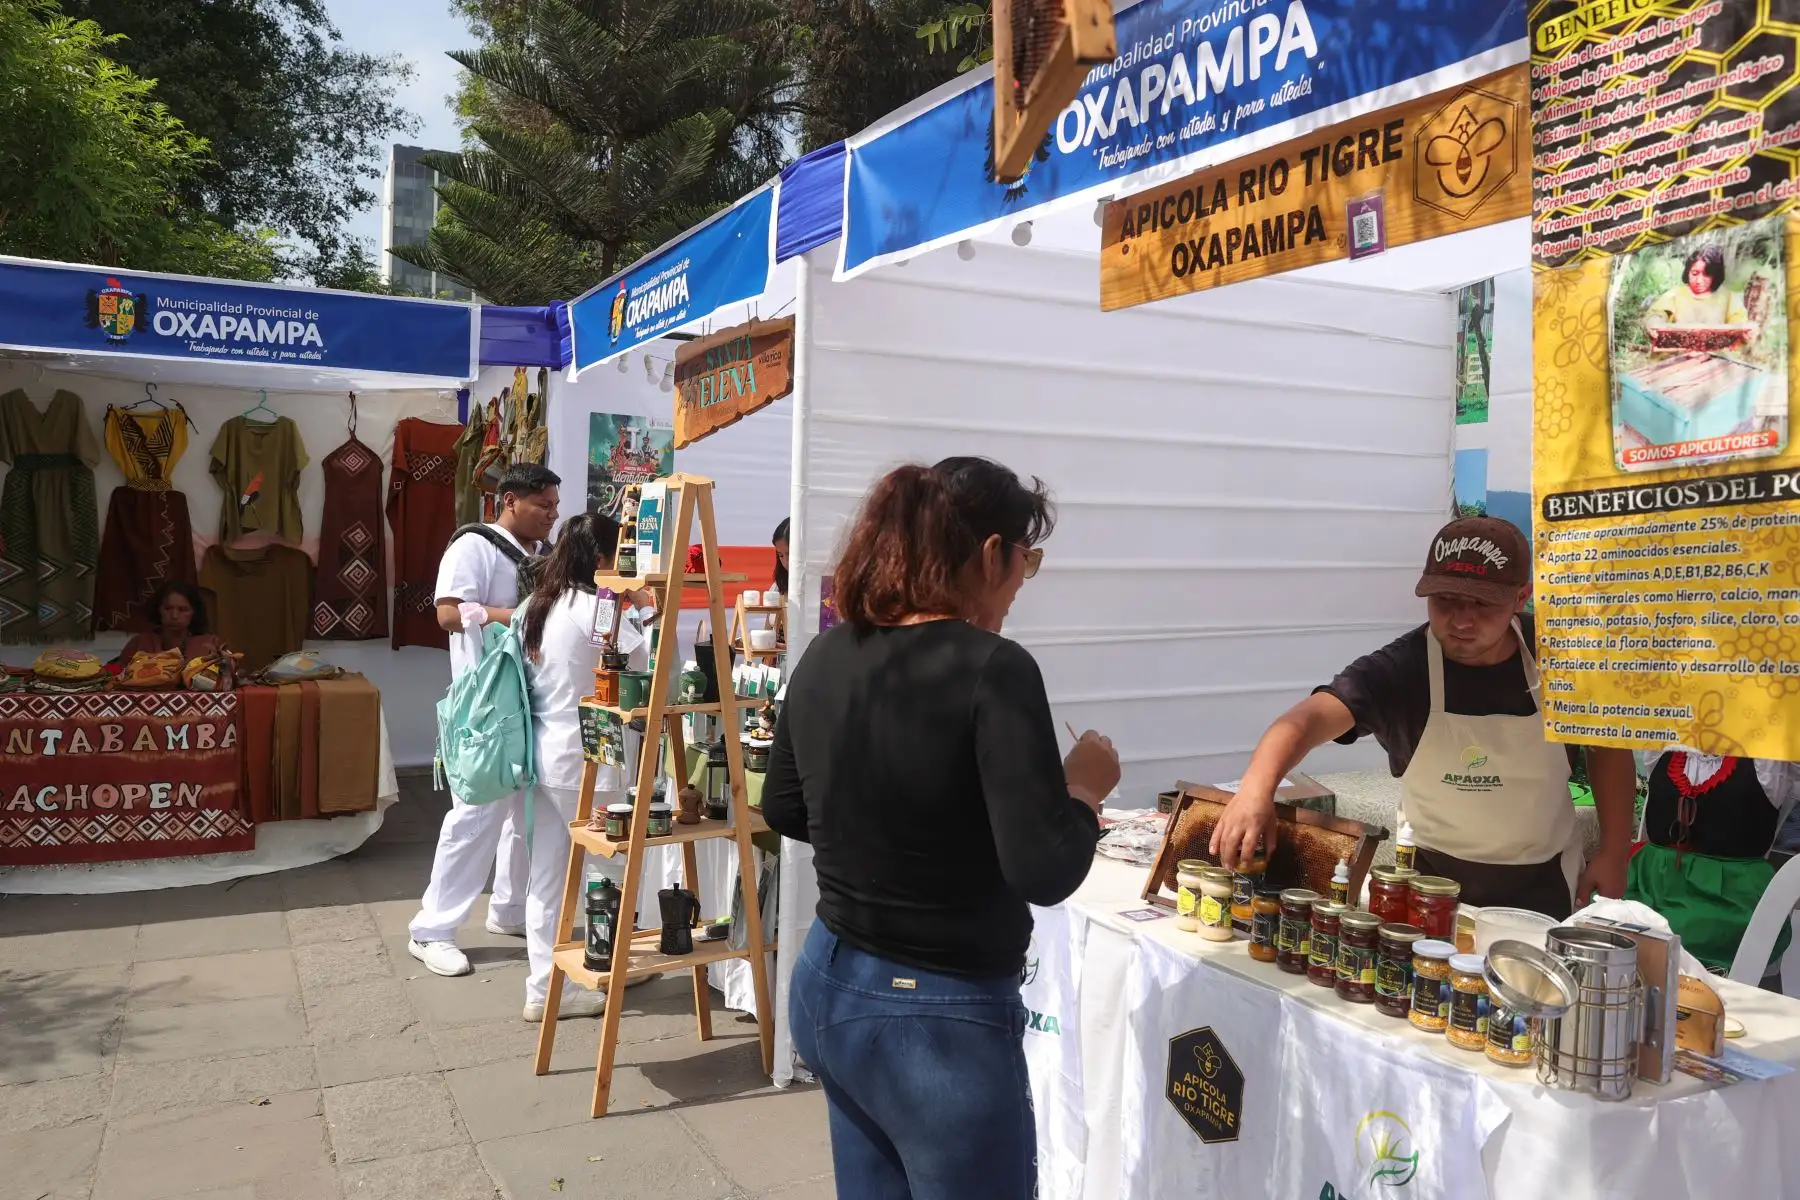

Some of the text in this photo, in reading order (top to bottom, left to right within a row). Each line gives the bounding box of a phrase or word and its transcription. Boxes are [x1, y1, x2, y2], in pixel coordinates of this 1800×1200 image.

[1541, 3, 1722, 77] Regula el azúcar en la sangre
[1544, 0, 1657, 46] BENEFIC
[1081, 25, 1176, 88] nicipalidad
[1542, 28, 1701, 99] Mejora la función cerebral
[1056, 0, 1318, 154] OXAPAMPA
[1542, 72, 1668, 121] Minimiza las alergias
[1542, 57, 1783, 145] Estimulante del sistema inmunológico
[1156, 132, 1176, 150] con
[1180, 112, 1216, 140] ustedes
[1220, 112, 1229, 132] y
[1234, 97, 1265, 126] para
[1543, 148, 1580, 166] Reduce
[1582, 139, 1594, 154] el
[1596, 128, 1632, 149] estrés
[1543, 165, 1596, 188] Promueve
[1599, 157, 1611, 171] la
[1694, 122, 1716, 141] del
[1720, 113, 1761, 134] sueño
[1120, 119, 1405, 242] APICOLA RIO TIGRE
[1542, 192, 1588, 211] Previene
[1591, 172, 1643, 198] infección
[1647, 166, 1661, 180] de
[1664, 145, 1745, 178] quemaduras
[1748, 141, 1757, 155] y
[1542, 167, 1749, 233] Tratamiento para el estreñimiento
[1542, 236, 1580, 256] Regula
[1583, 233, 1599, 245] los
[1602, 222, 1649, 245] procesos
[1652, 197, 1733, 226] hormonales
[1736, 194, 1754, 208] en
[1757, 184, 1771, 201] el
[1171, 205, 1327, 278] OXAPAMPA
[157, 296, 319, 320] Municipalidad Provincial de
[626, 273, 690, 329] OXAPAMPA
[153, 310, 324, 348] OXAPAMPA
[246, 347, 269, 357] ustedes
[271, 351, 278, 360] y
[280, 351, 297, 360] para
[700, 360, 757, 409] ELENA
[1629, 432, 1769, 462] SOMOS APICULTORES
[1548, 485, 1700, 517] BENEFICIOS
[1701, 476, 1766, 502] DEL
[1548, 513, 1800, 542] Contiene aproximadamente 25% de protein
[1435, 536, 1509, 570] Oxapampa
[1548, 540, 1741, 565] Aporta 22 aminoacidos esenciales.
[1548, 573, 1591, 584] Contiene
[1595, 569, 1649, 582] vitaminas
[1549, 587, 1800, 607] Aporta minerales como Hierro, calcio, man
[1546, 610, 1800, 629] mangnesio, potasio, fosforo, silice, cloro, co
[1549, 636, 1715, 651] Restablece la flora bacteriana.
[1549, 658, 1800, 674] Fortalece el crecimiento y desarrollo de los
[1549, 680, 1576, 691] niños.
[1553, 701, 1693, 718] Mejora la potencia sexual.
[1554, 721, 1679, 740] Contrarresta la anemia.
[1444, 773, 1500, 783] APAOXA
[1173, 1081, 1235, 1128] RIO TIGRE
[1184, 1072, 1226, 1105] APICOLA
